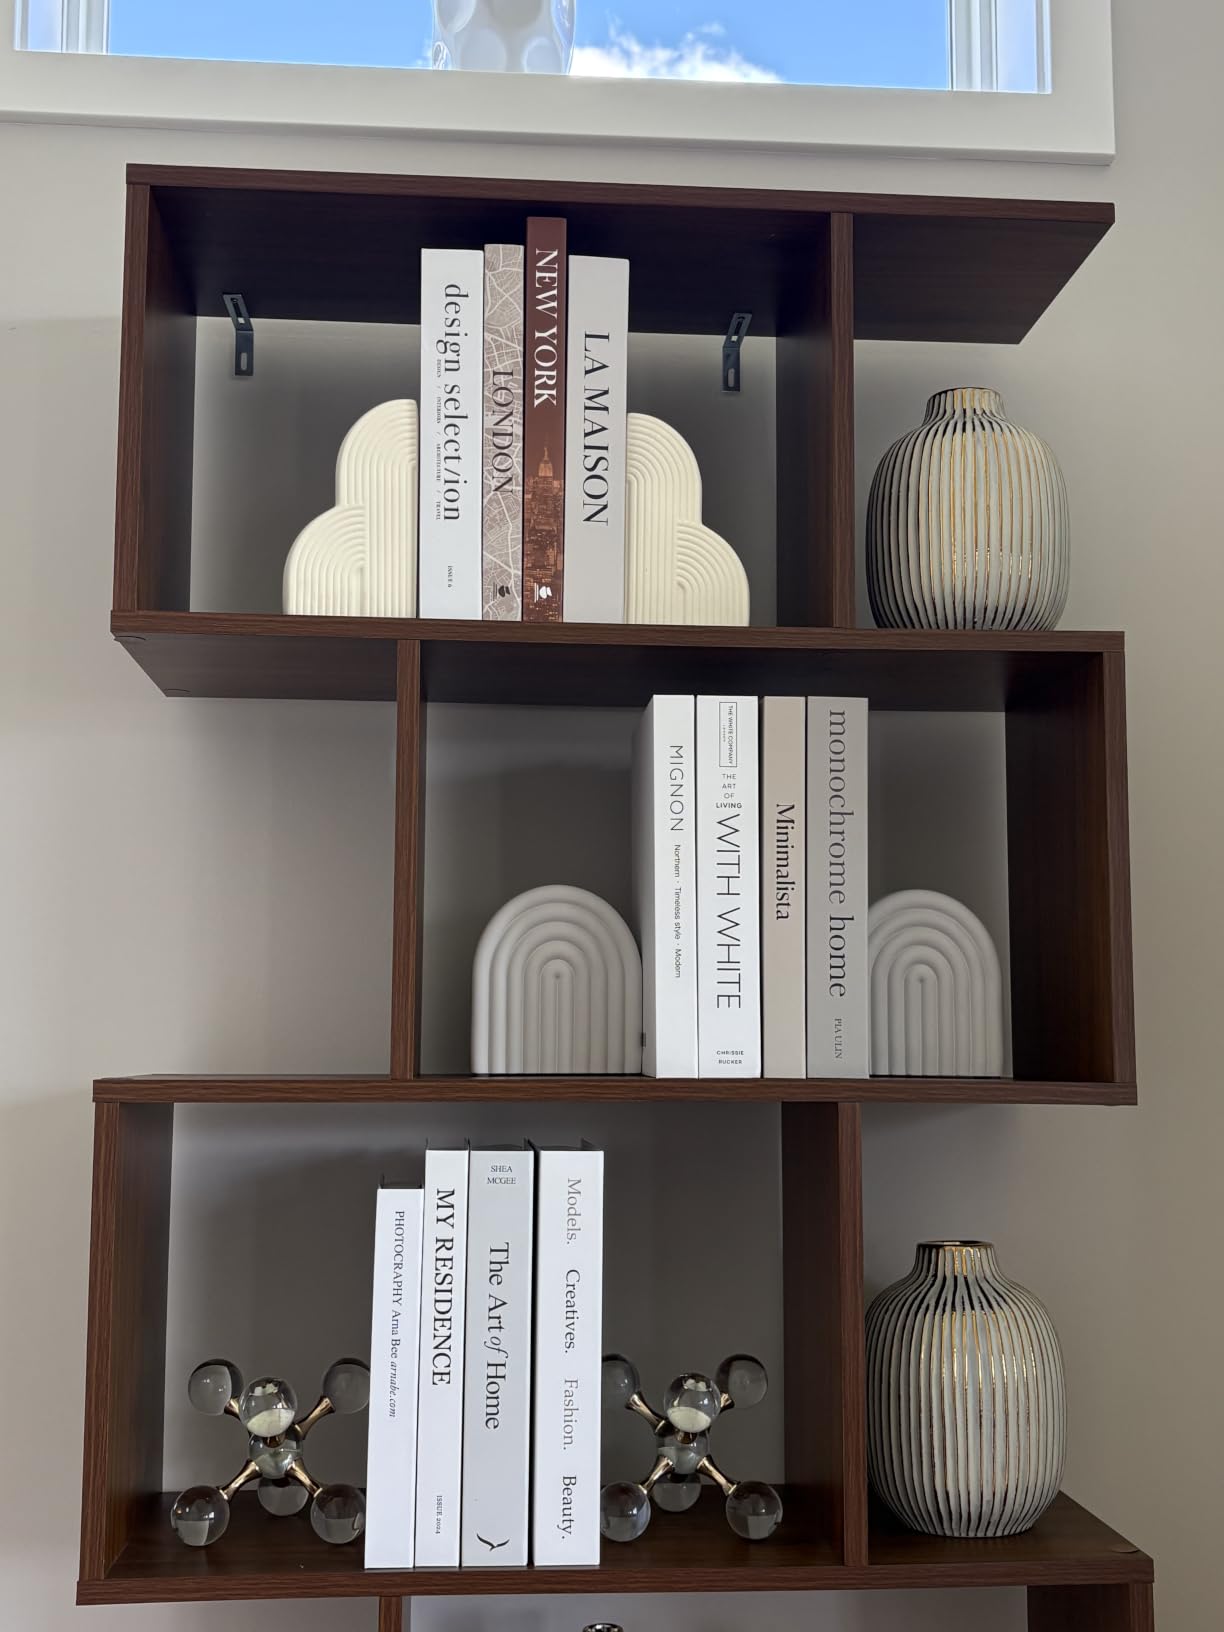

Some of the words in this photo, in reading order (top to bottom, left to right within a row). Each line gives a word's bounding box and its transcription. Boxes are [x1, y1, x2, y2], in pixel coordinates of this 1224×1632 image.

[536, 249, 558, 318] NEW
[436, 284, 469, 372] design
[584, 332, 609, 376] LA
[534, 326, 557, 407] YORK
[444, 384, 468, 520] select/ion
[492, 370, 514, 495] LONDON
[583, 386, 609, 525] MAISON
[670, 746, 684, 830] MIGNON
[724, 792, 734, 800] OF
[829, 710, 854, 904] monochrome
[717, 814, 740, 895] WITH
[776, 804, 795, 920] Minimalista
[674, 887, 682, 919] Timeless
[717, 907, 740, 1008] WHITE
[829, 915, 854, 997] home
[436, 1189, 455, 1228] MY
[567, 1178, 581, 1244] Models.
[489, 1242, 509, 1285] The
[392, 1310, 401, 1335] Arna
[432, 1237, 453, 1385] RESIDENCE
[488, 1294, 507, 1332] Art
[565, 1270, 580, 1353] Creatives.
[391, 1339, 400, 1358] Bee
[484, 1336, 508, 1358] of
[389, 1362, 399, 1417] arnabe.com
[485, 1361, 506, 1429] Home
[563, 1380, 579, 1450] Fashion.
[434, 1518, 442, 1534] 2024
[557, 1476, 576, 1539] Beauty.
